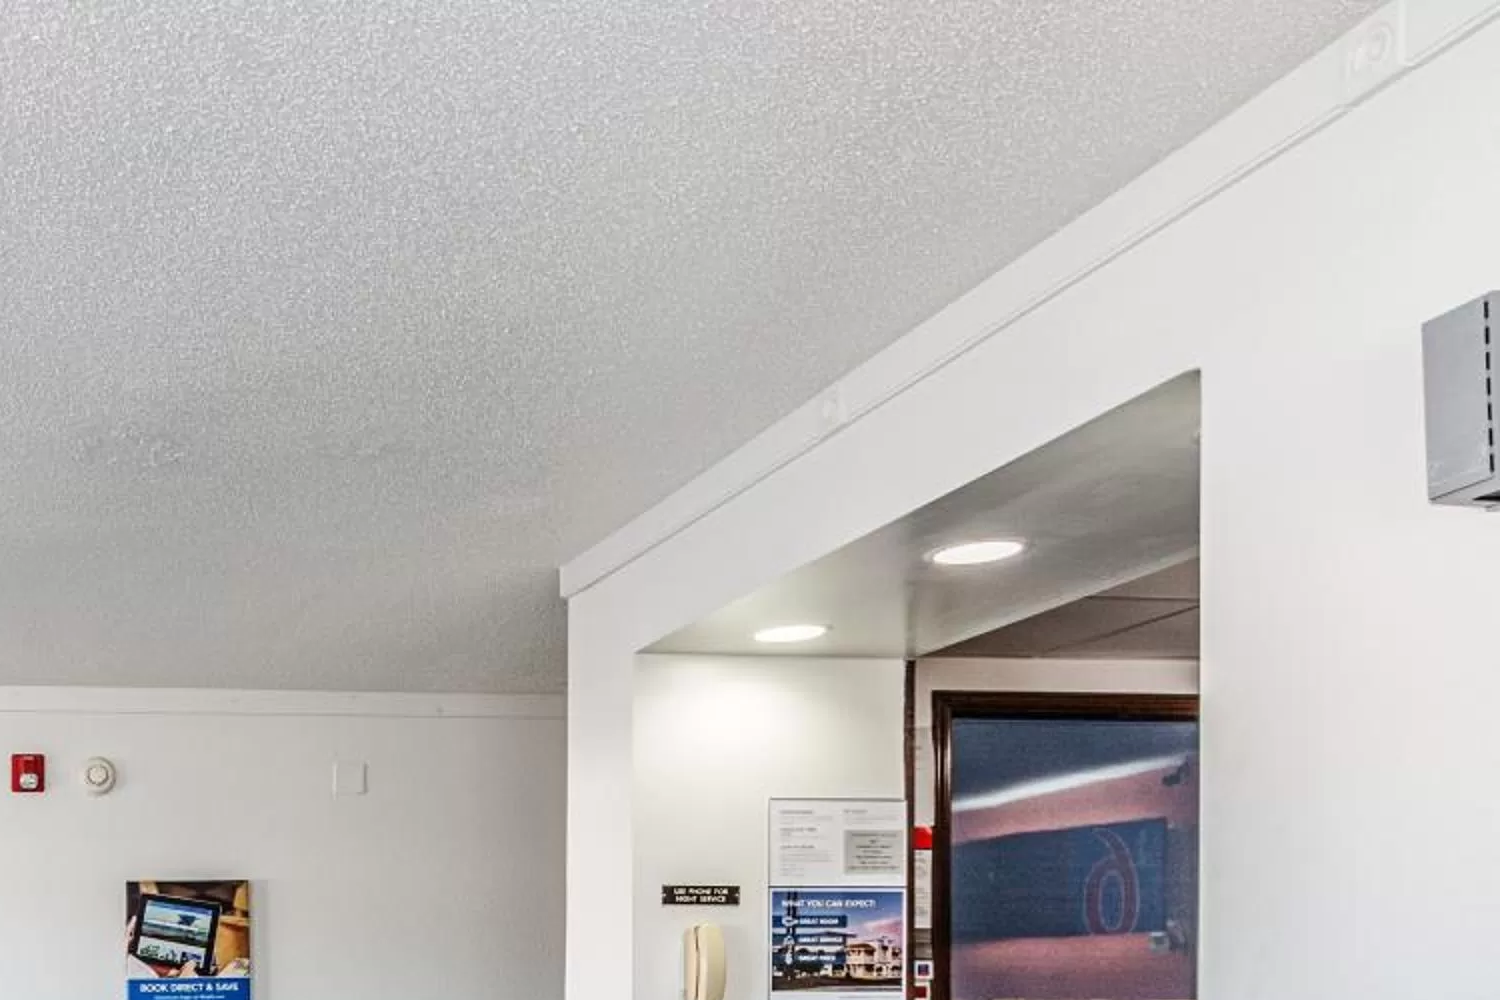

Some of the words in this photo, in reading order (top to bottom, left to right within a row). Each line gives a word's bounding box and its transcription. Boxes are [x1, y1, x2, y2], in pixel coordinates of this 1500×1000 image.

[806, 899, 824, 908] YOU
[825, 899, 843, 908] CAN
[139, 983, 169, 993] BOOK
[170, 983, 204, 992] DIRECT
[205, 982, 214, 992] &
[215, 982, 239, 991] SAVE
